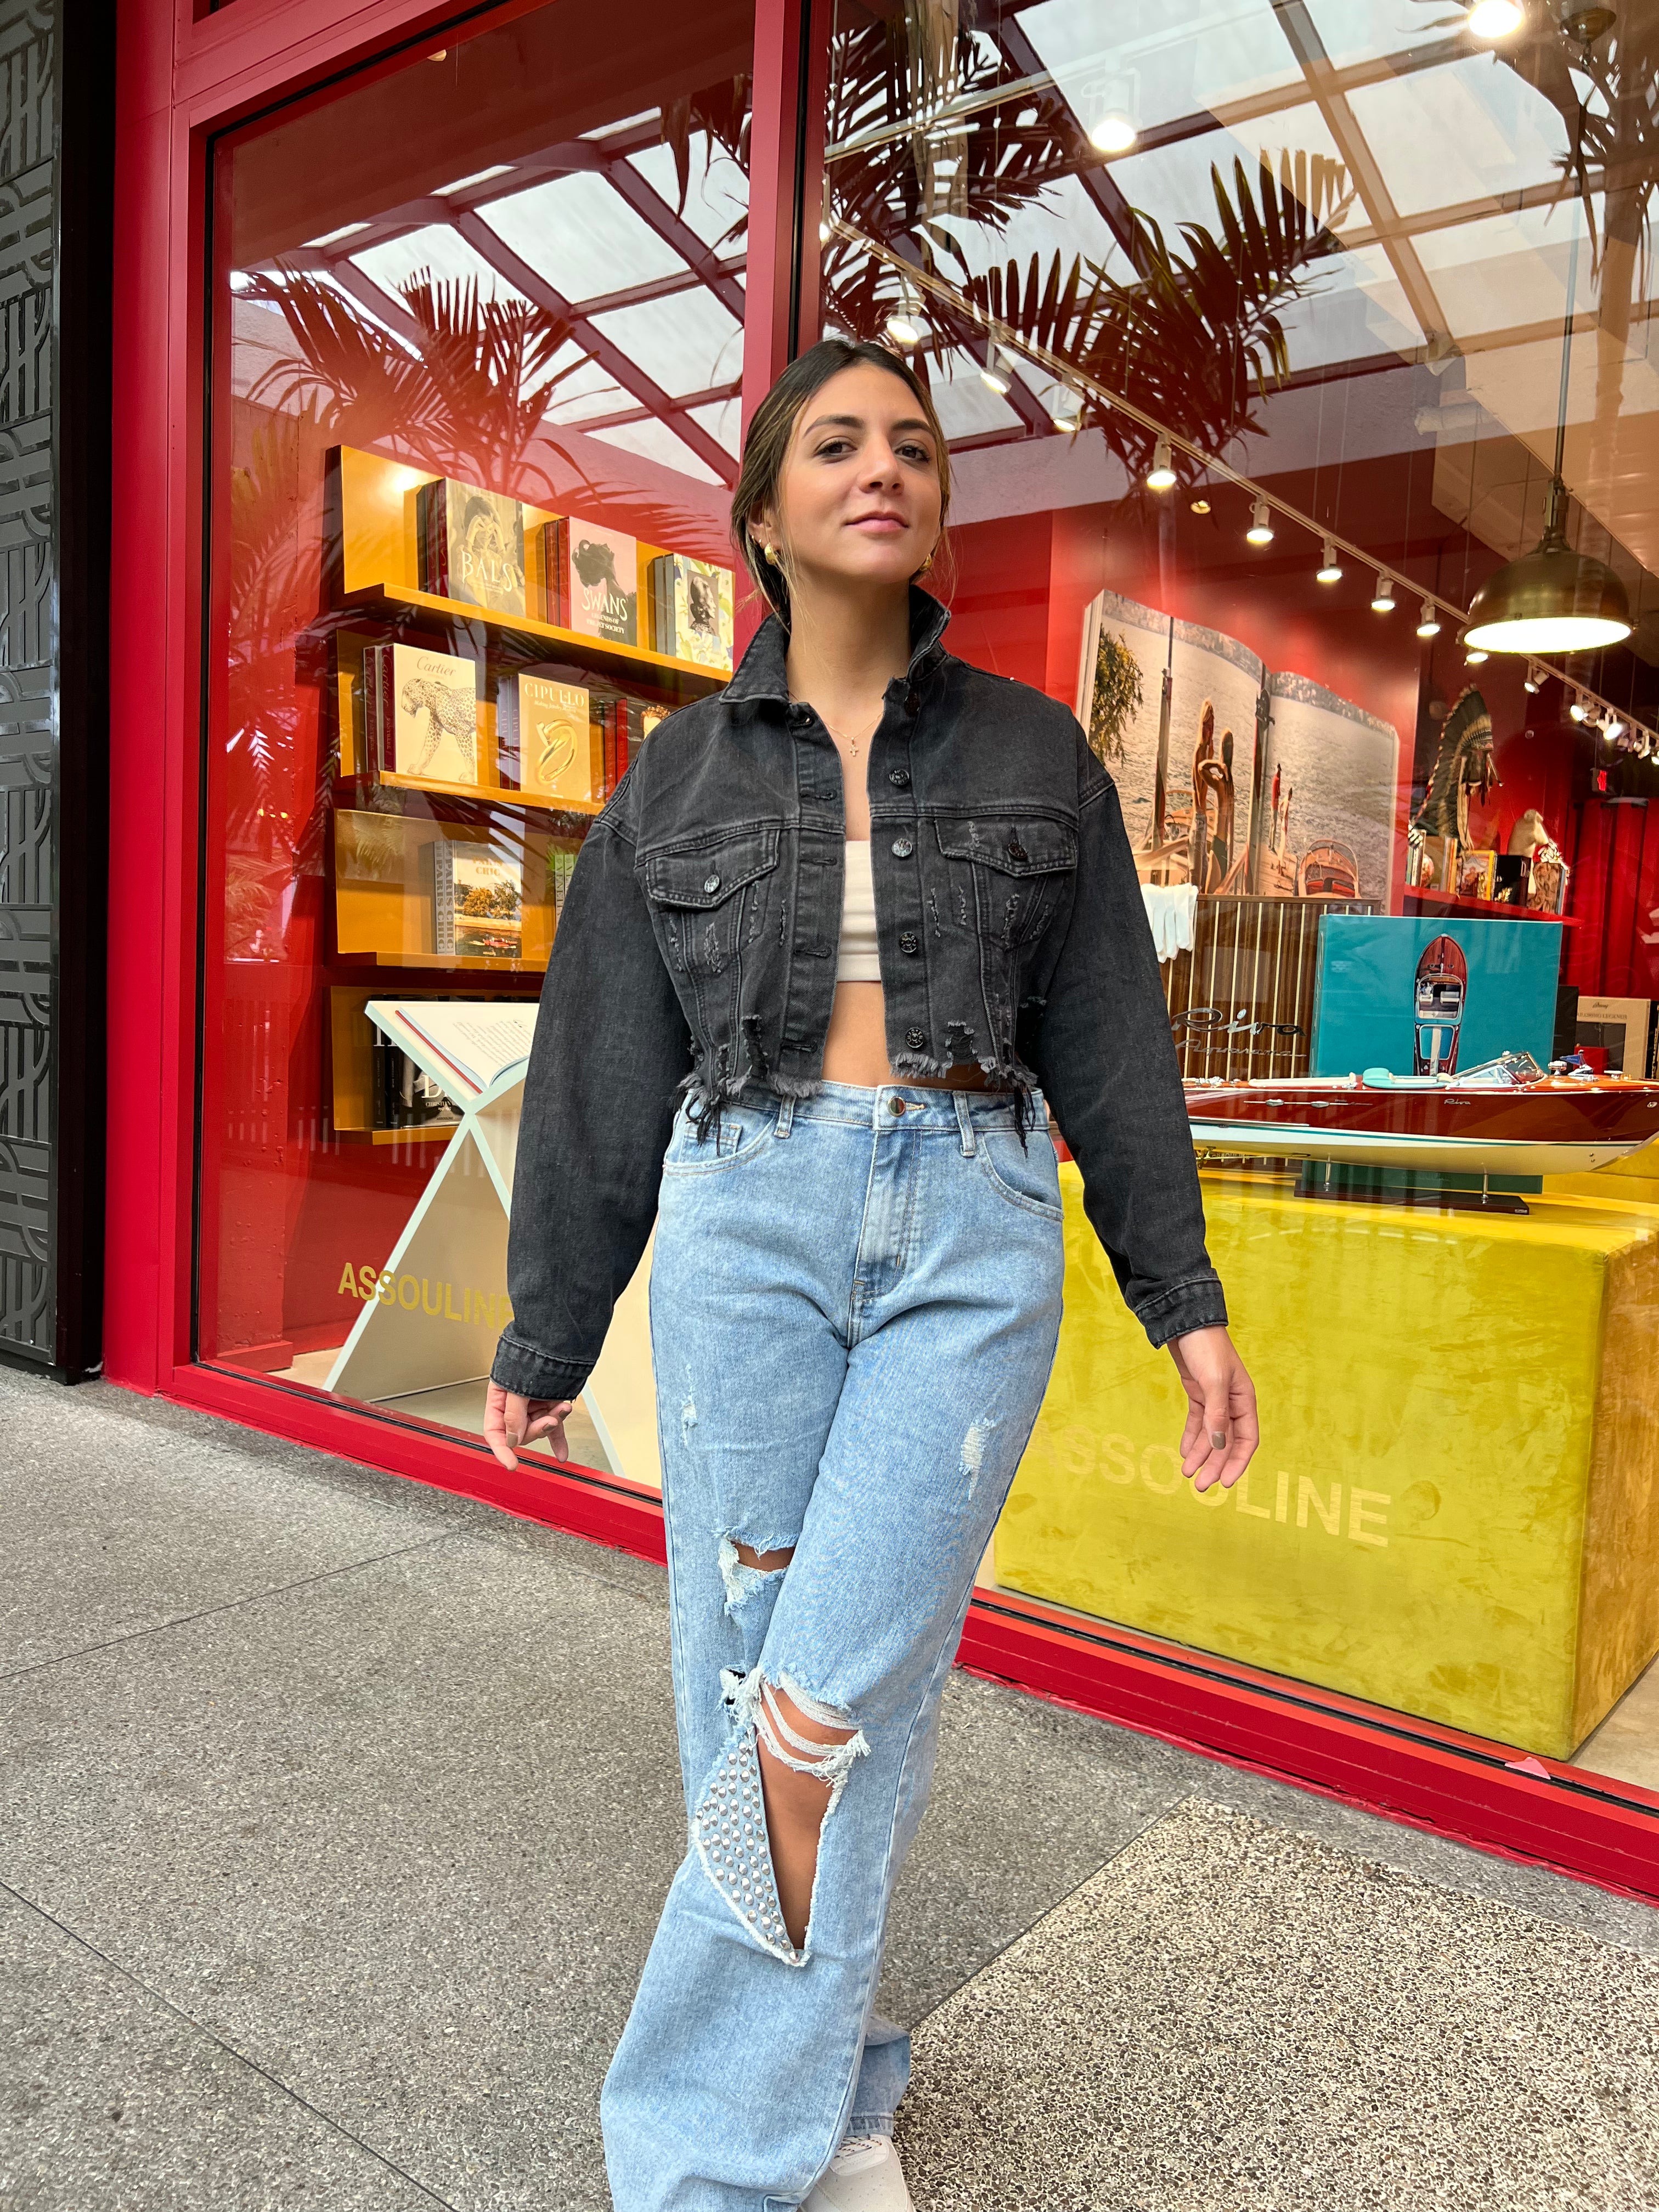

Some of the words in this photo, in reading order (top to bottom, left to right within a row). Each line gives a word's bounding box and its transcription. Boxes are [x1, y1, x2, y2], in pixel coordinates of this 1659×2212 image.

[461, 549, 512, 592] BALS
[582, 588, 628, 621] SWANS
[605, 623, 624, 634] SOCIETY
[382, 654, 391, 707] Cartier
[417, 656, 456, 676] Cartier
[524, 682, 584, 708] CIPULLO
[436, 859, 445, 907] PARIS
[476, 866, 500, 876] CHIC
[446, 910, 454, 949] CHIC
[1171, 1007, 1307, 1037] Riva
